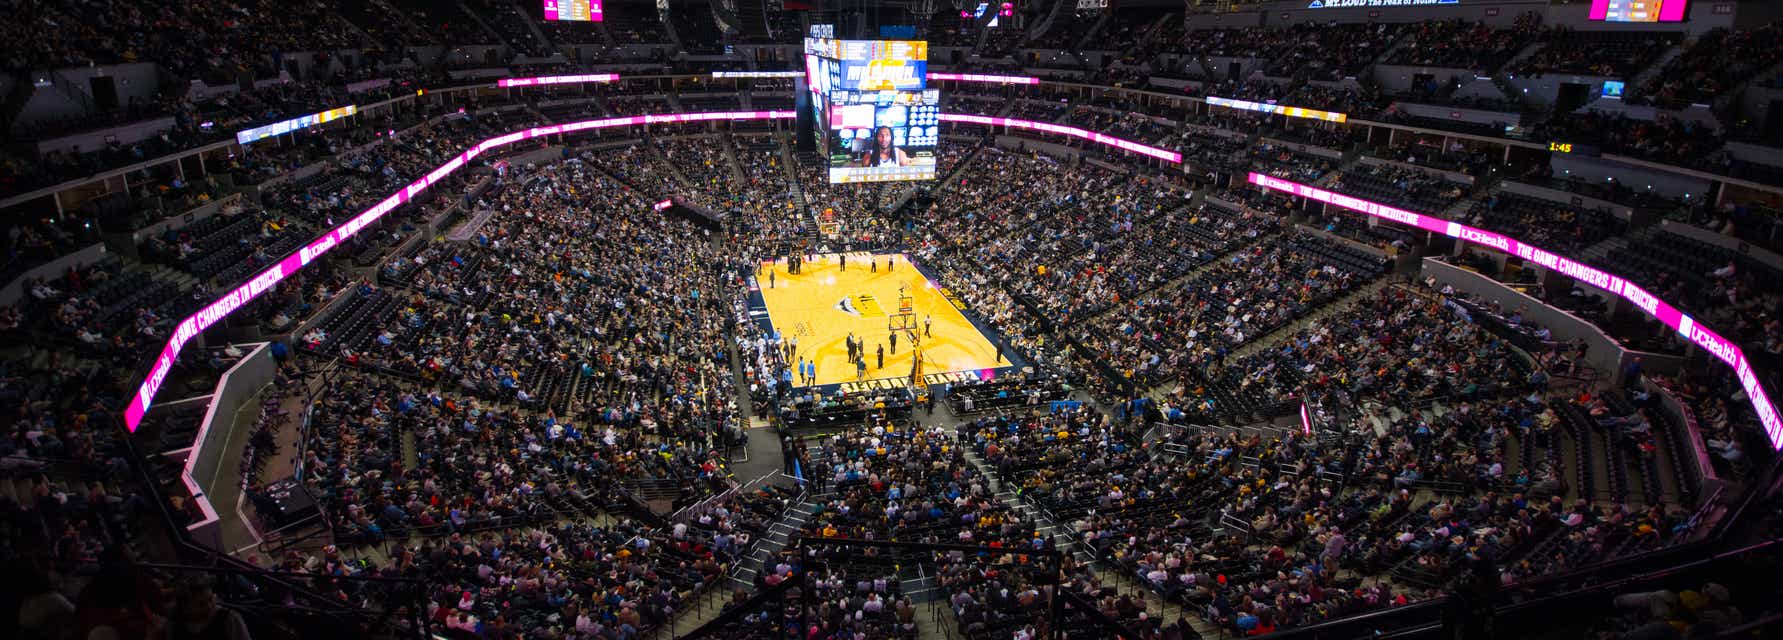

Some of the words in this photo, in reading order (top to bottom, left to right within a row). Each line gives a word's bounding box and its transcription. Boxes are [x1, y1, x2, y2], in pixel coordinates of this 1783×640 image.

[1549, 142, 1572, 153] 1:45
[1461, 228, 1509, 251] UCHealth
[1516, 242, 1533, 260] THE
[1533, 249, 1558, 269] GAME
[1558, 256, 1610, 289] CHANGERS
[1609, 276, 1623, 296] IN
[1623, 281, 1659, 316] MEDICINE
[147, 352, 171, 400] UCHealth
[177, 315, 198, 346] GAME
[197, 289, 241, 330] CHANGERS
[240, 283, 250, 305] IN
[248, 263, 284, 298] MEDICINE
[1691, 325, 1737, 367] UCHealth
